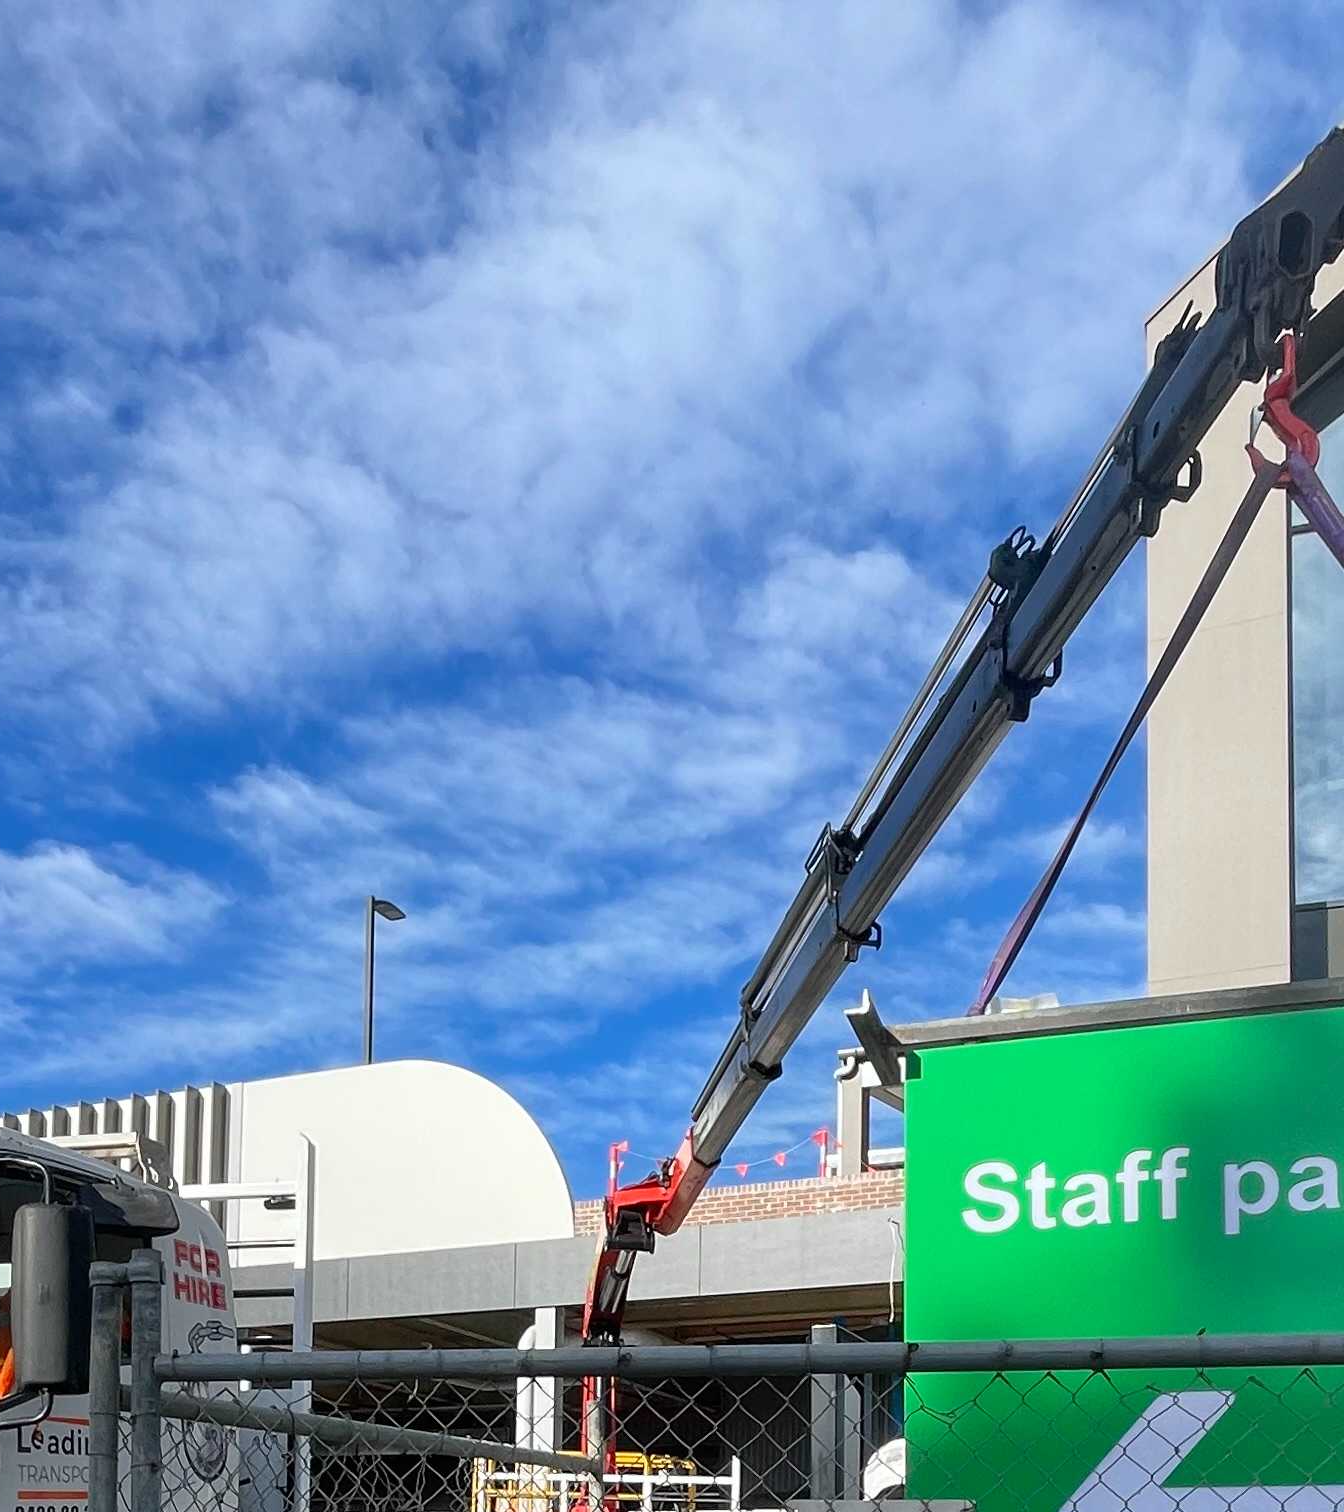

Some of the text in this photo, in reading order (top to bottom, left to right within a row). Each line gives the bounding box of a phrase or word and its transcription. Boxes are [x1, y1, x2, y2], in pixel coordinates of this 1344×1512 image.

[962, 1146, 1190, 1234] Staff
[173, 1239, 222, 1278] FOR
[173, 1271, 228, 1312] HIRE
[17, 1424, 89, 1456] Leadi
[17, 1463, 89, 1484] TRANSPO
